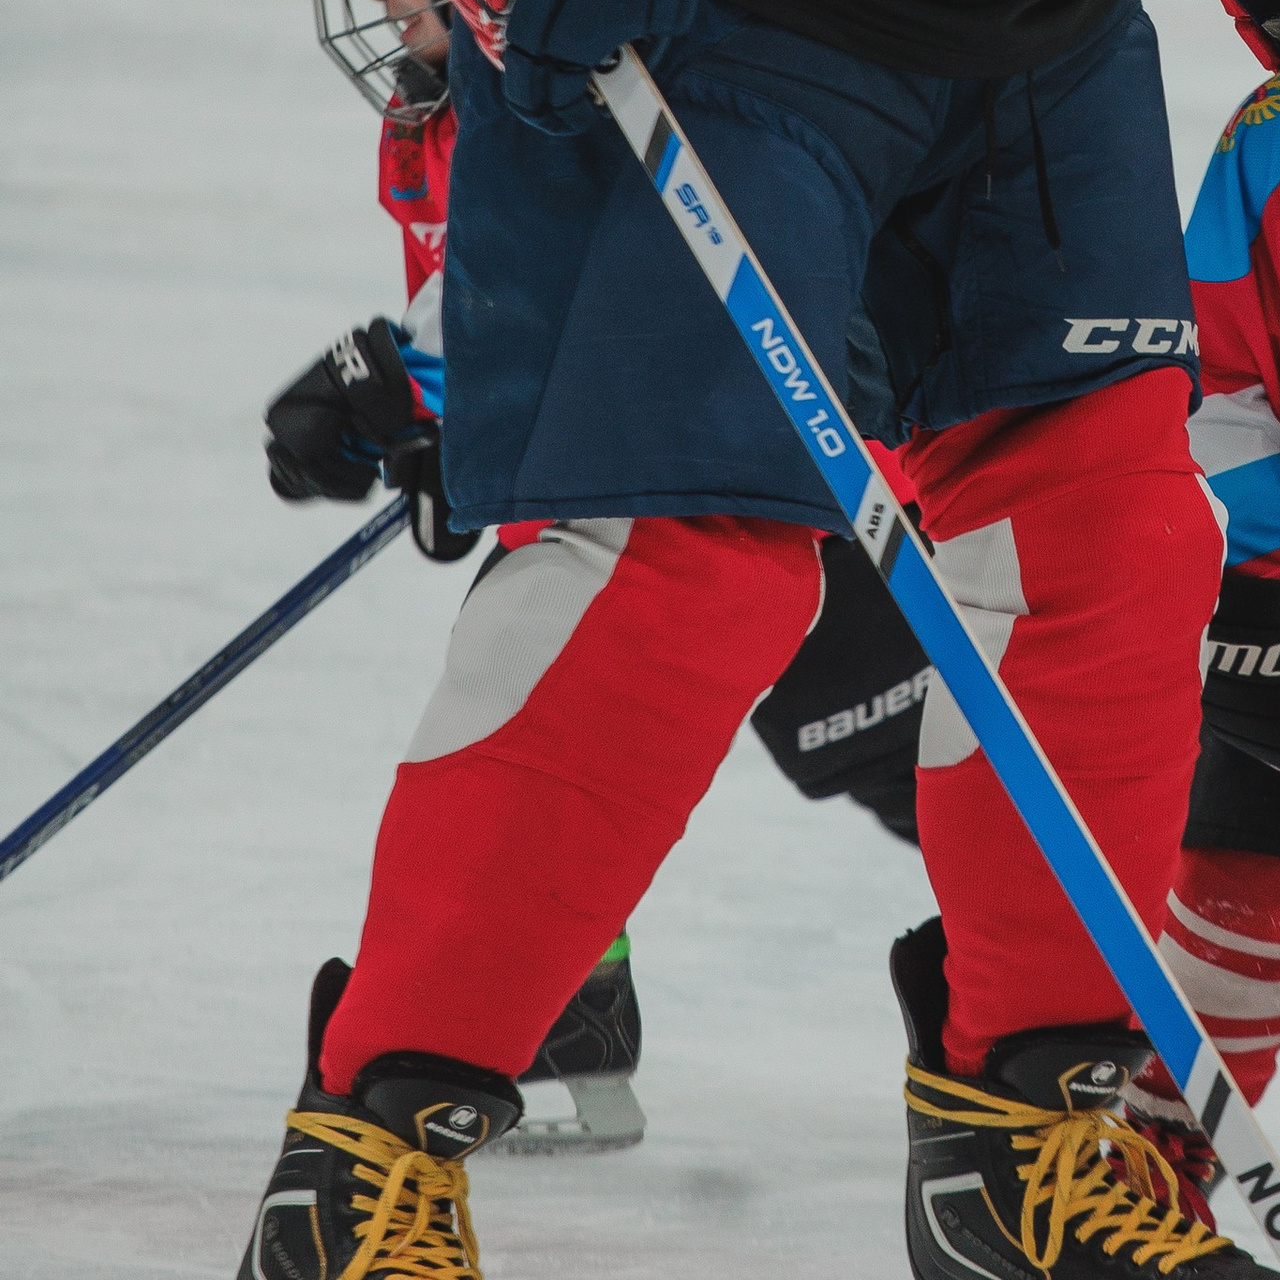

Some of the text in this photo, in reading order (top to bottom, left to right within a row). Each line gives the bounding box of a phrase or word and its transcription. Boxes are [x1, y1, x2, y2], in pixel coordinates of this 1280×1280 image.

[675, 183, 709, 228] SR
[1062, 318, 1200, 357] CCM
[751, 317, 846, 458] NDW 1.0
